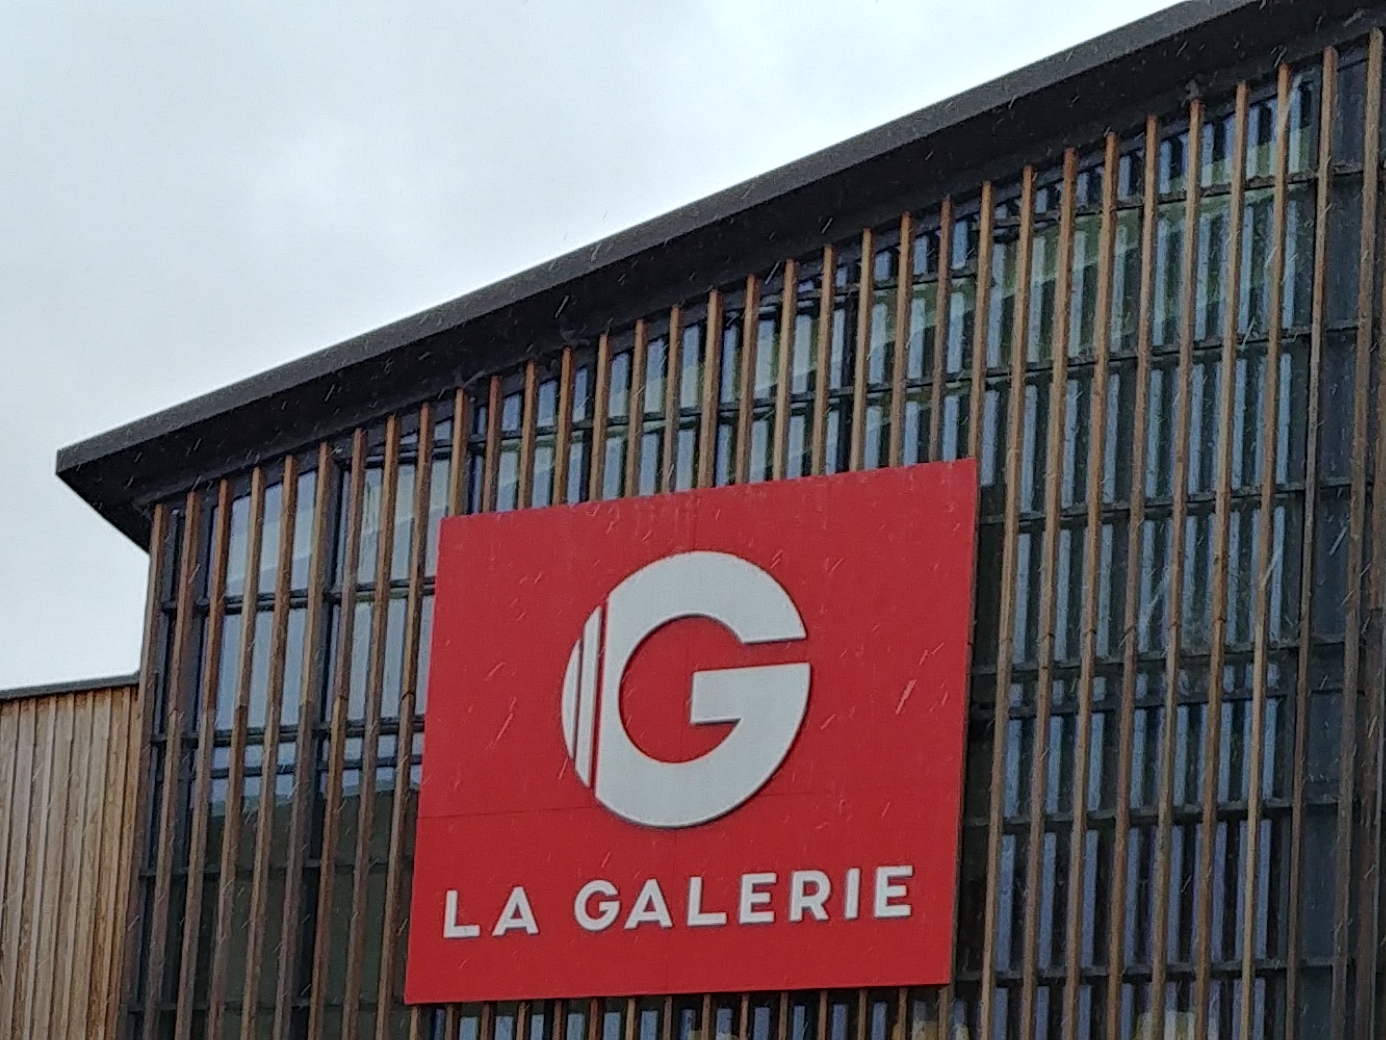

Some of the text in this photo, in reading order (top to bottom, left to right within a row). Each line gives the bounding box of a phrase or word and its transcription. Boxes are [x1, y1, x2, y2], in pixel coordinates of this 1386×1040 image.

[561, 550, 812, 829] G
[442, 864, 914, 940] LA GALERIE
